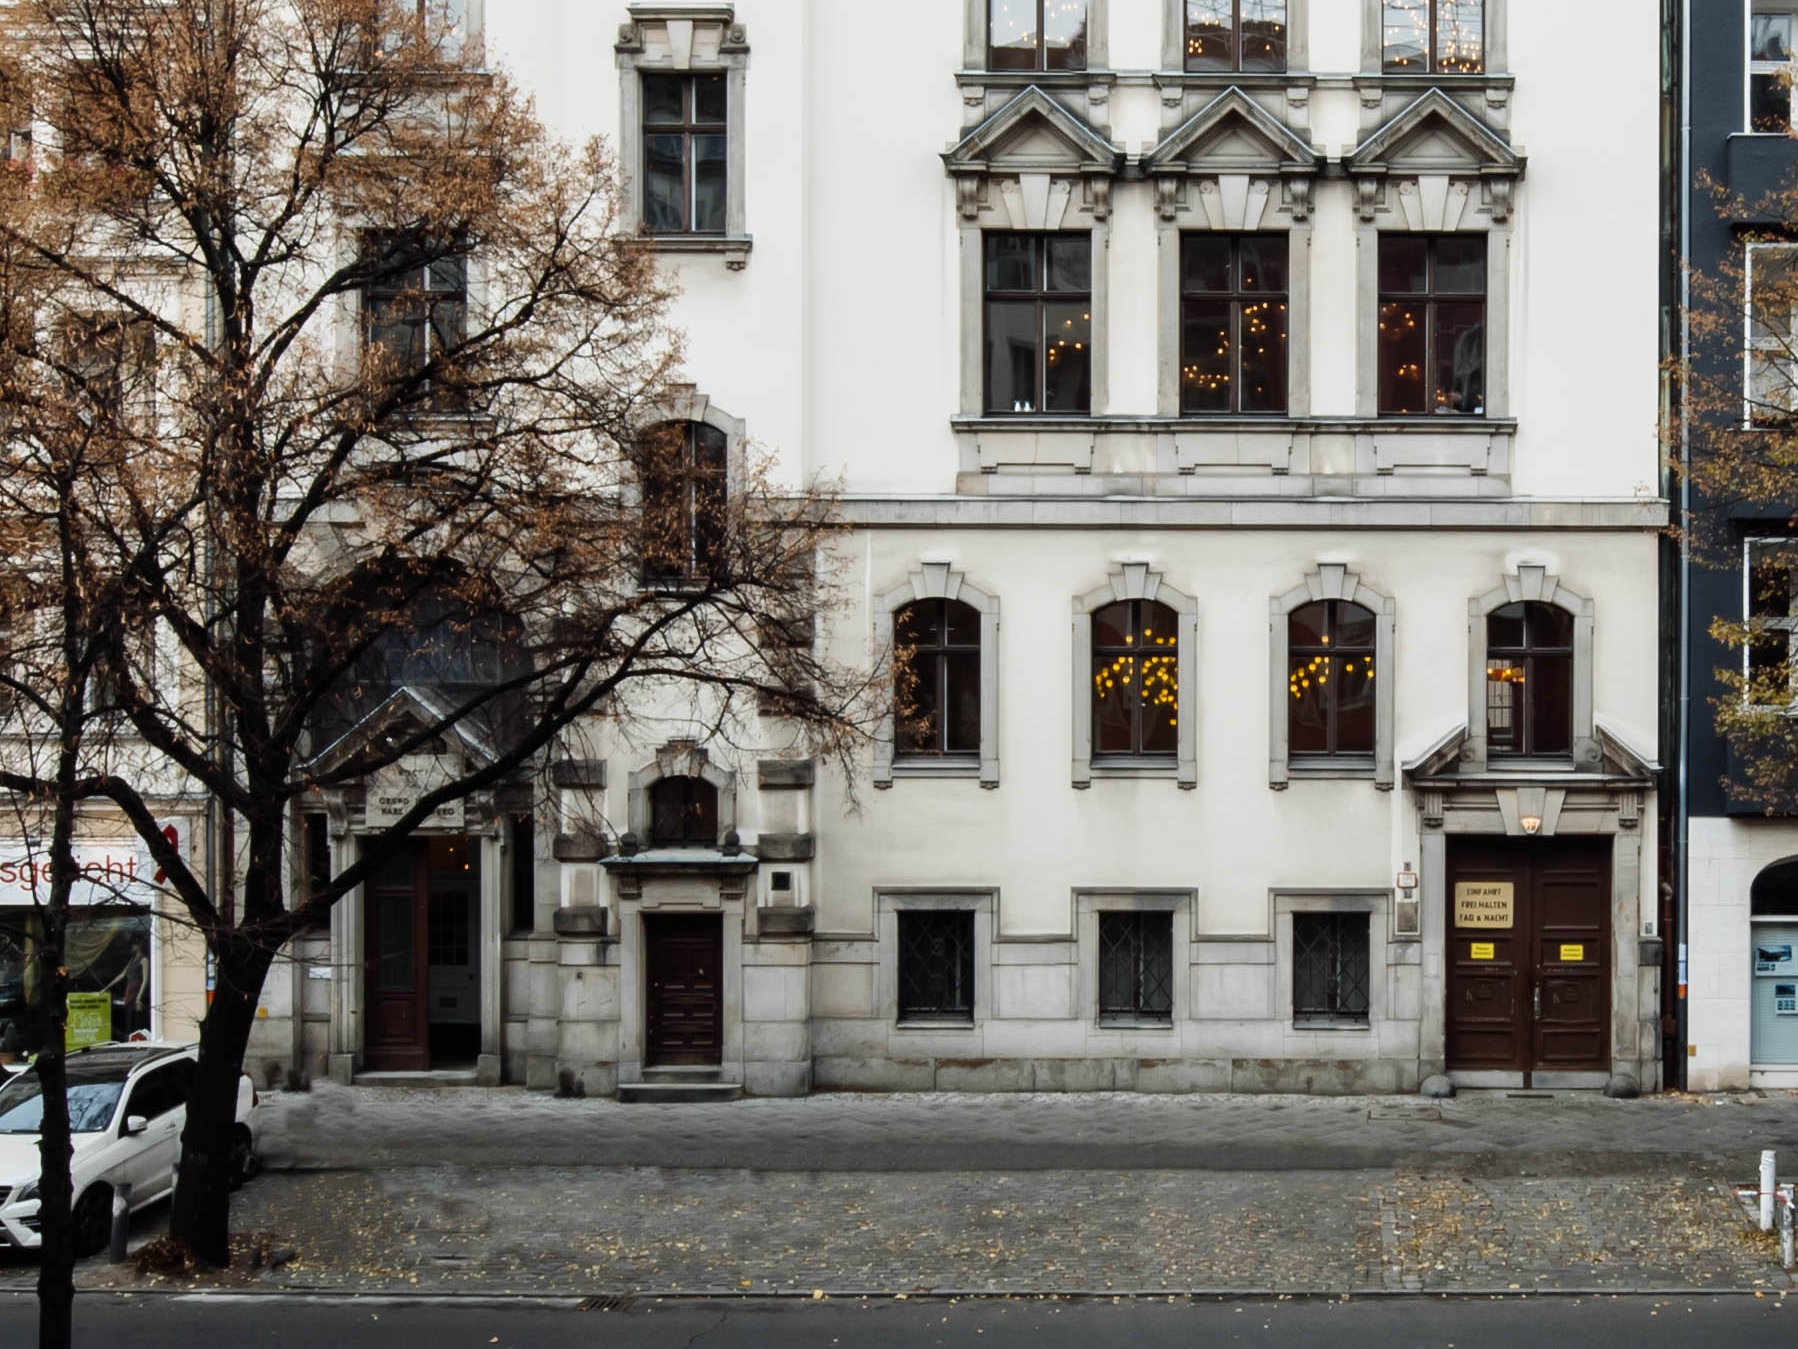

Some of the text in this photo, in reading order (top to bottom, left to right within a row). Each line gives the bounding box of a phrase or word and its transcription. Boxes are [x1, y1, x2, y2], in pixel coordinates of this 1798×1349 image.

[0, 854, 138, 892] sgeicht
[1466, 887, 1502, 897] EINFAHRT
[1459, 913, 1475, 923] TAG
[1483, 913, 1510, 923] NACHT
